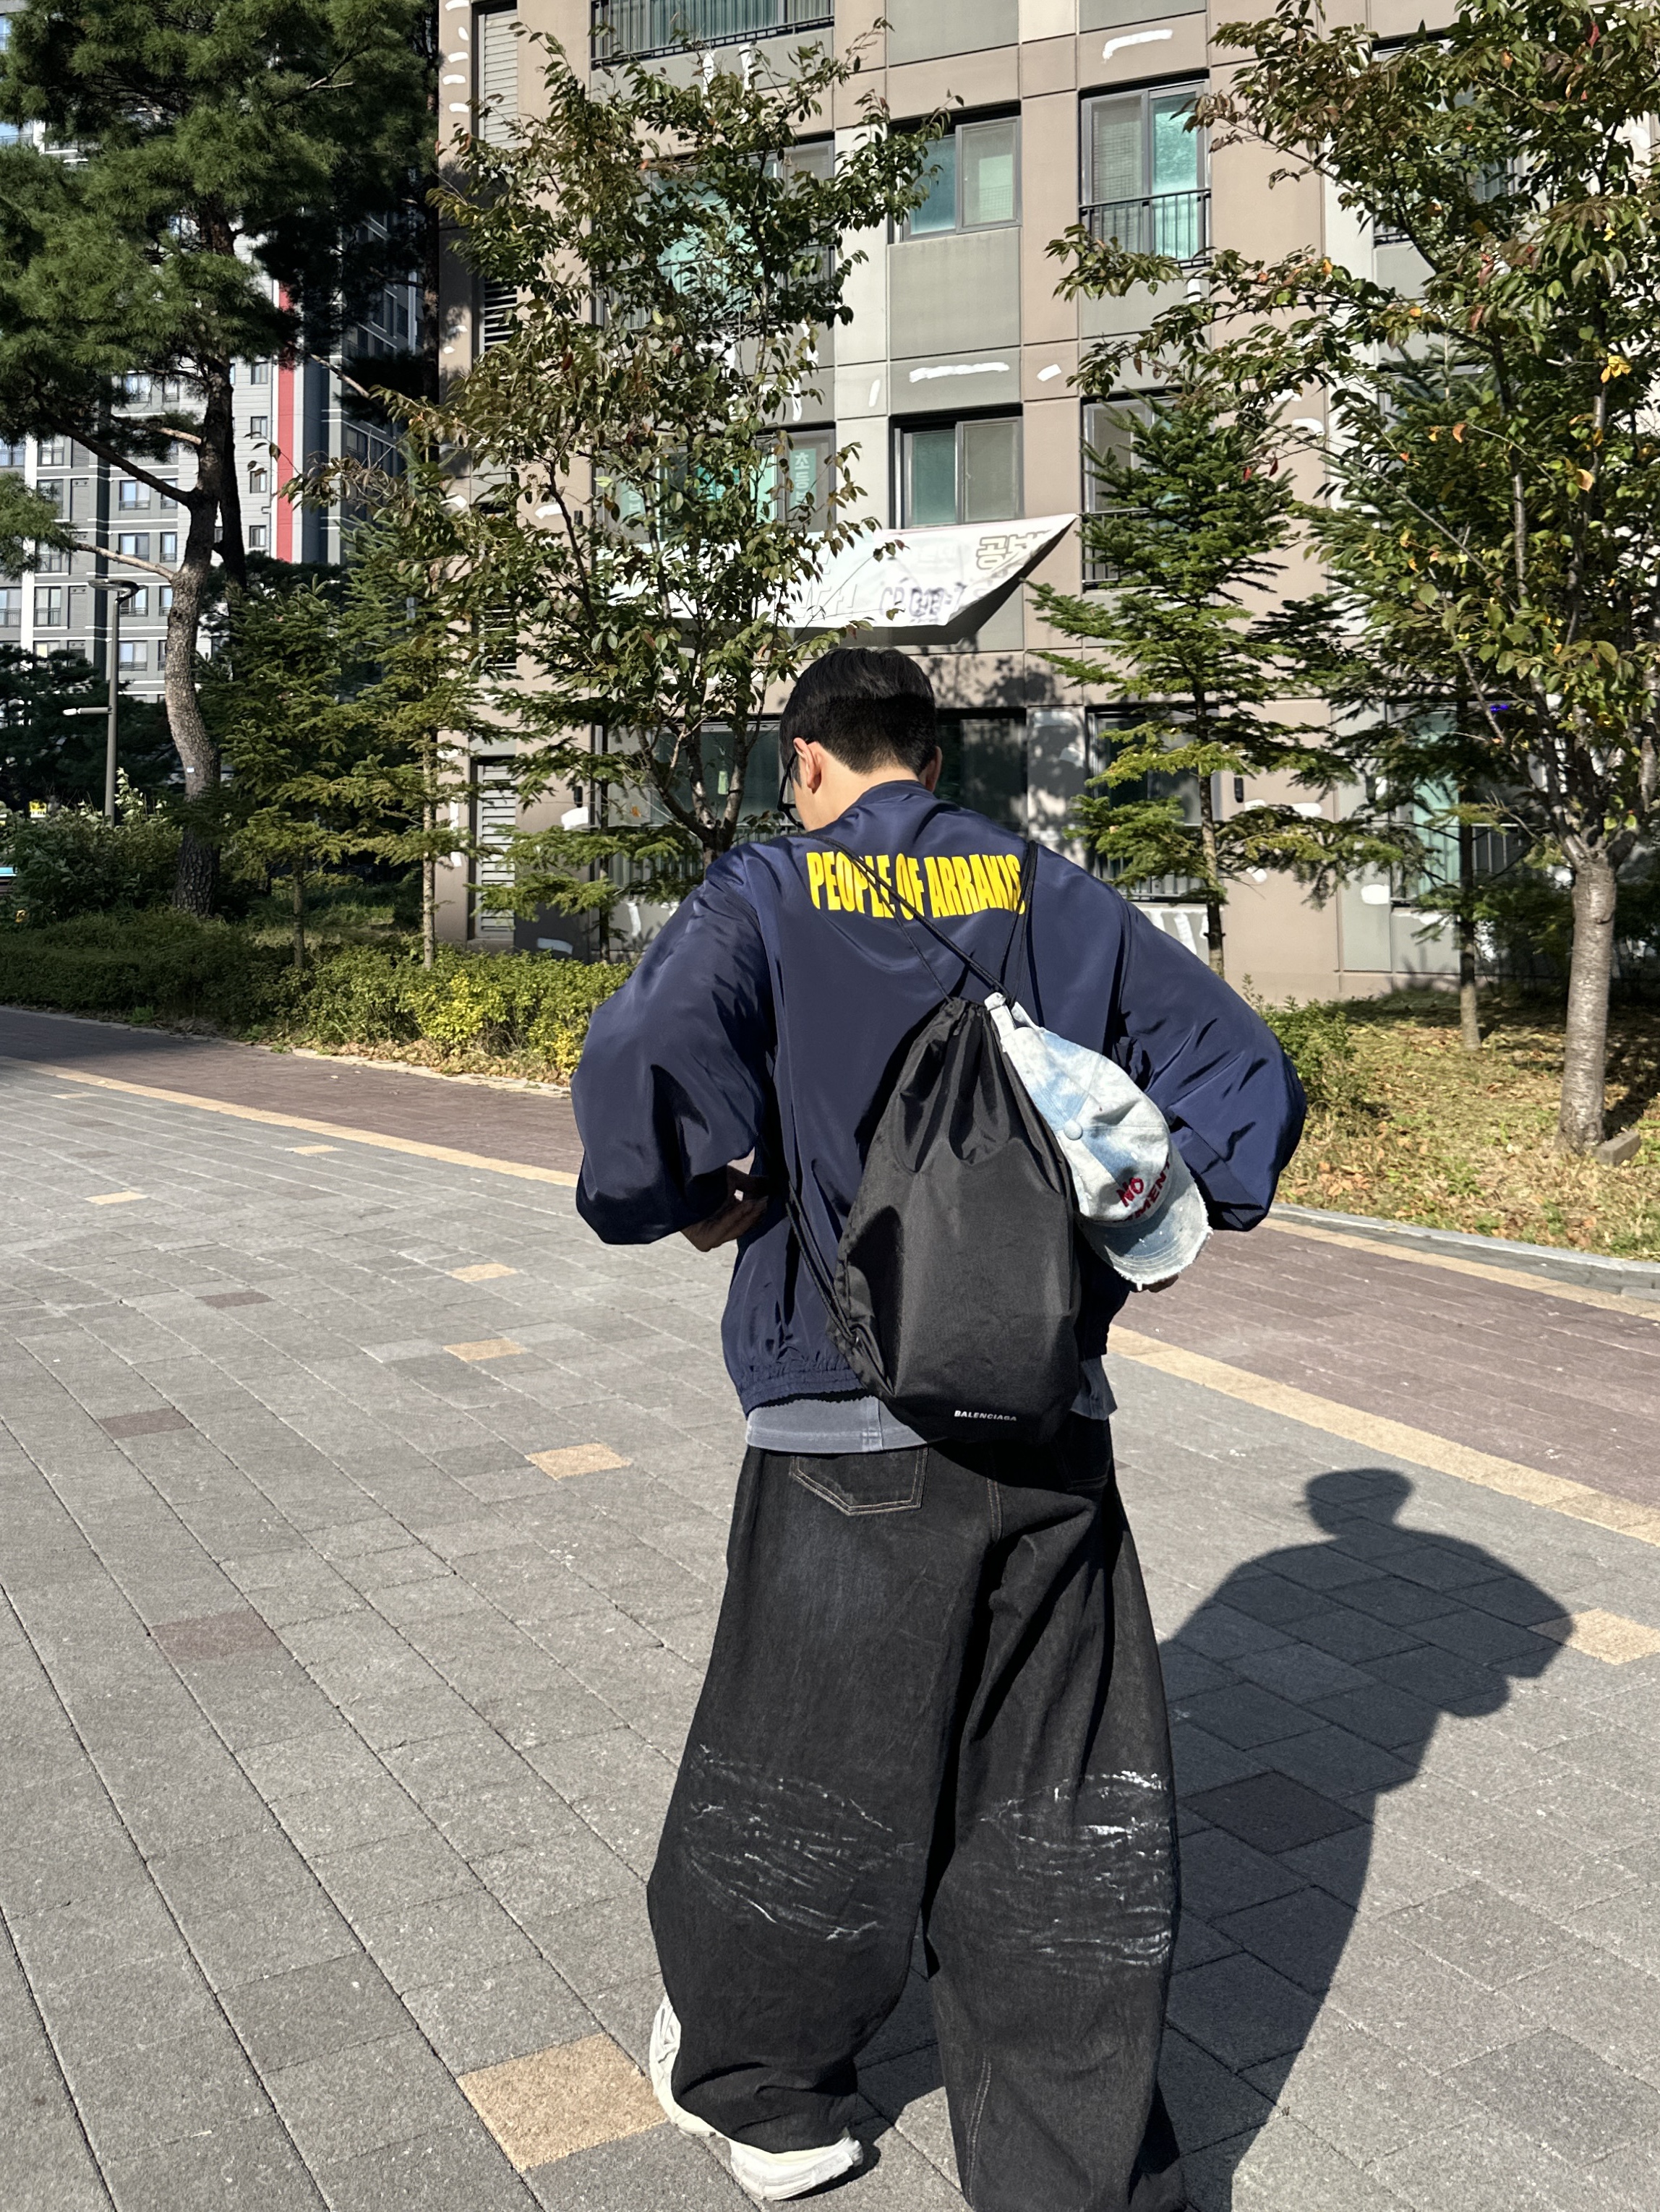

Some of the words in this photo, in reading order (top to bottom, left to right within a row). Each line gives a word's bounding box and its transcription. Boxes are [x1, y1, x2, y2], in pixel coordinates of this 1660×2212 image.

[806, 852, 895, 918] PEOPLE
[896, 853, 924, 920] OF
[923, 854, 1025, 918] ARRAKIS
[1116, 1177, 1144, 1207] NO
[954, 1410, 1017, 1421] BALENCIAGA
